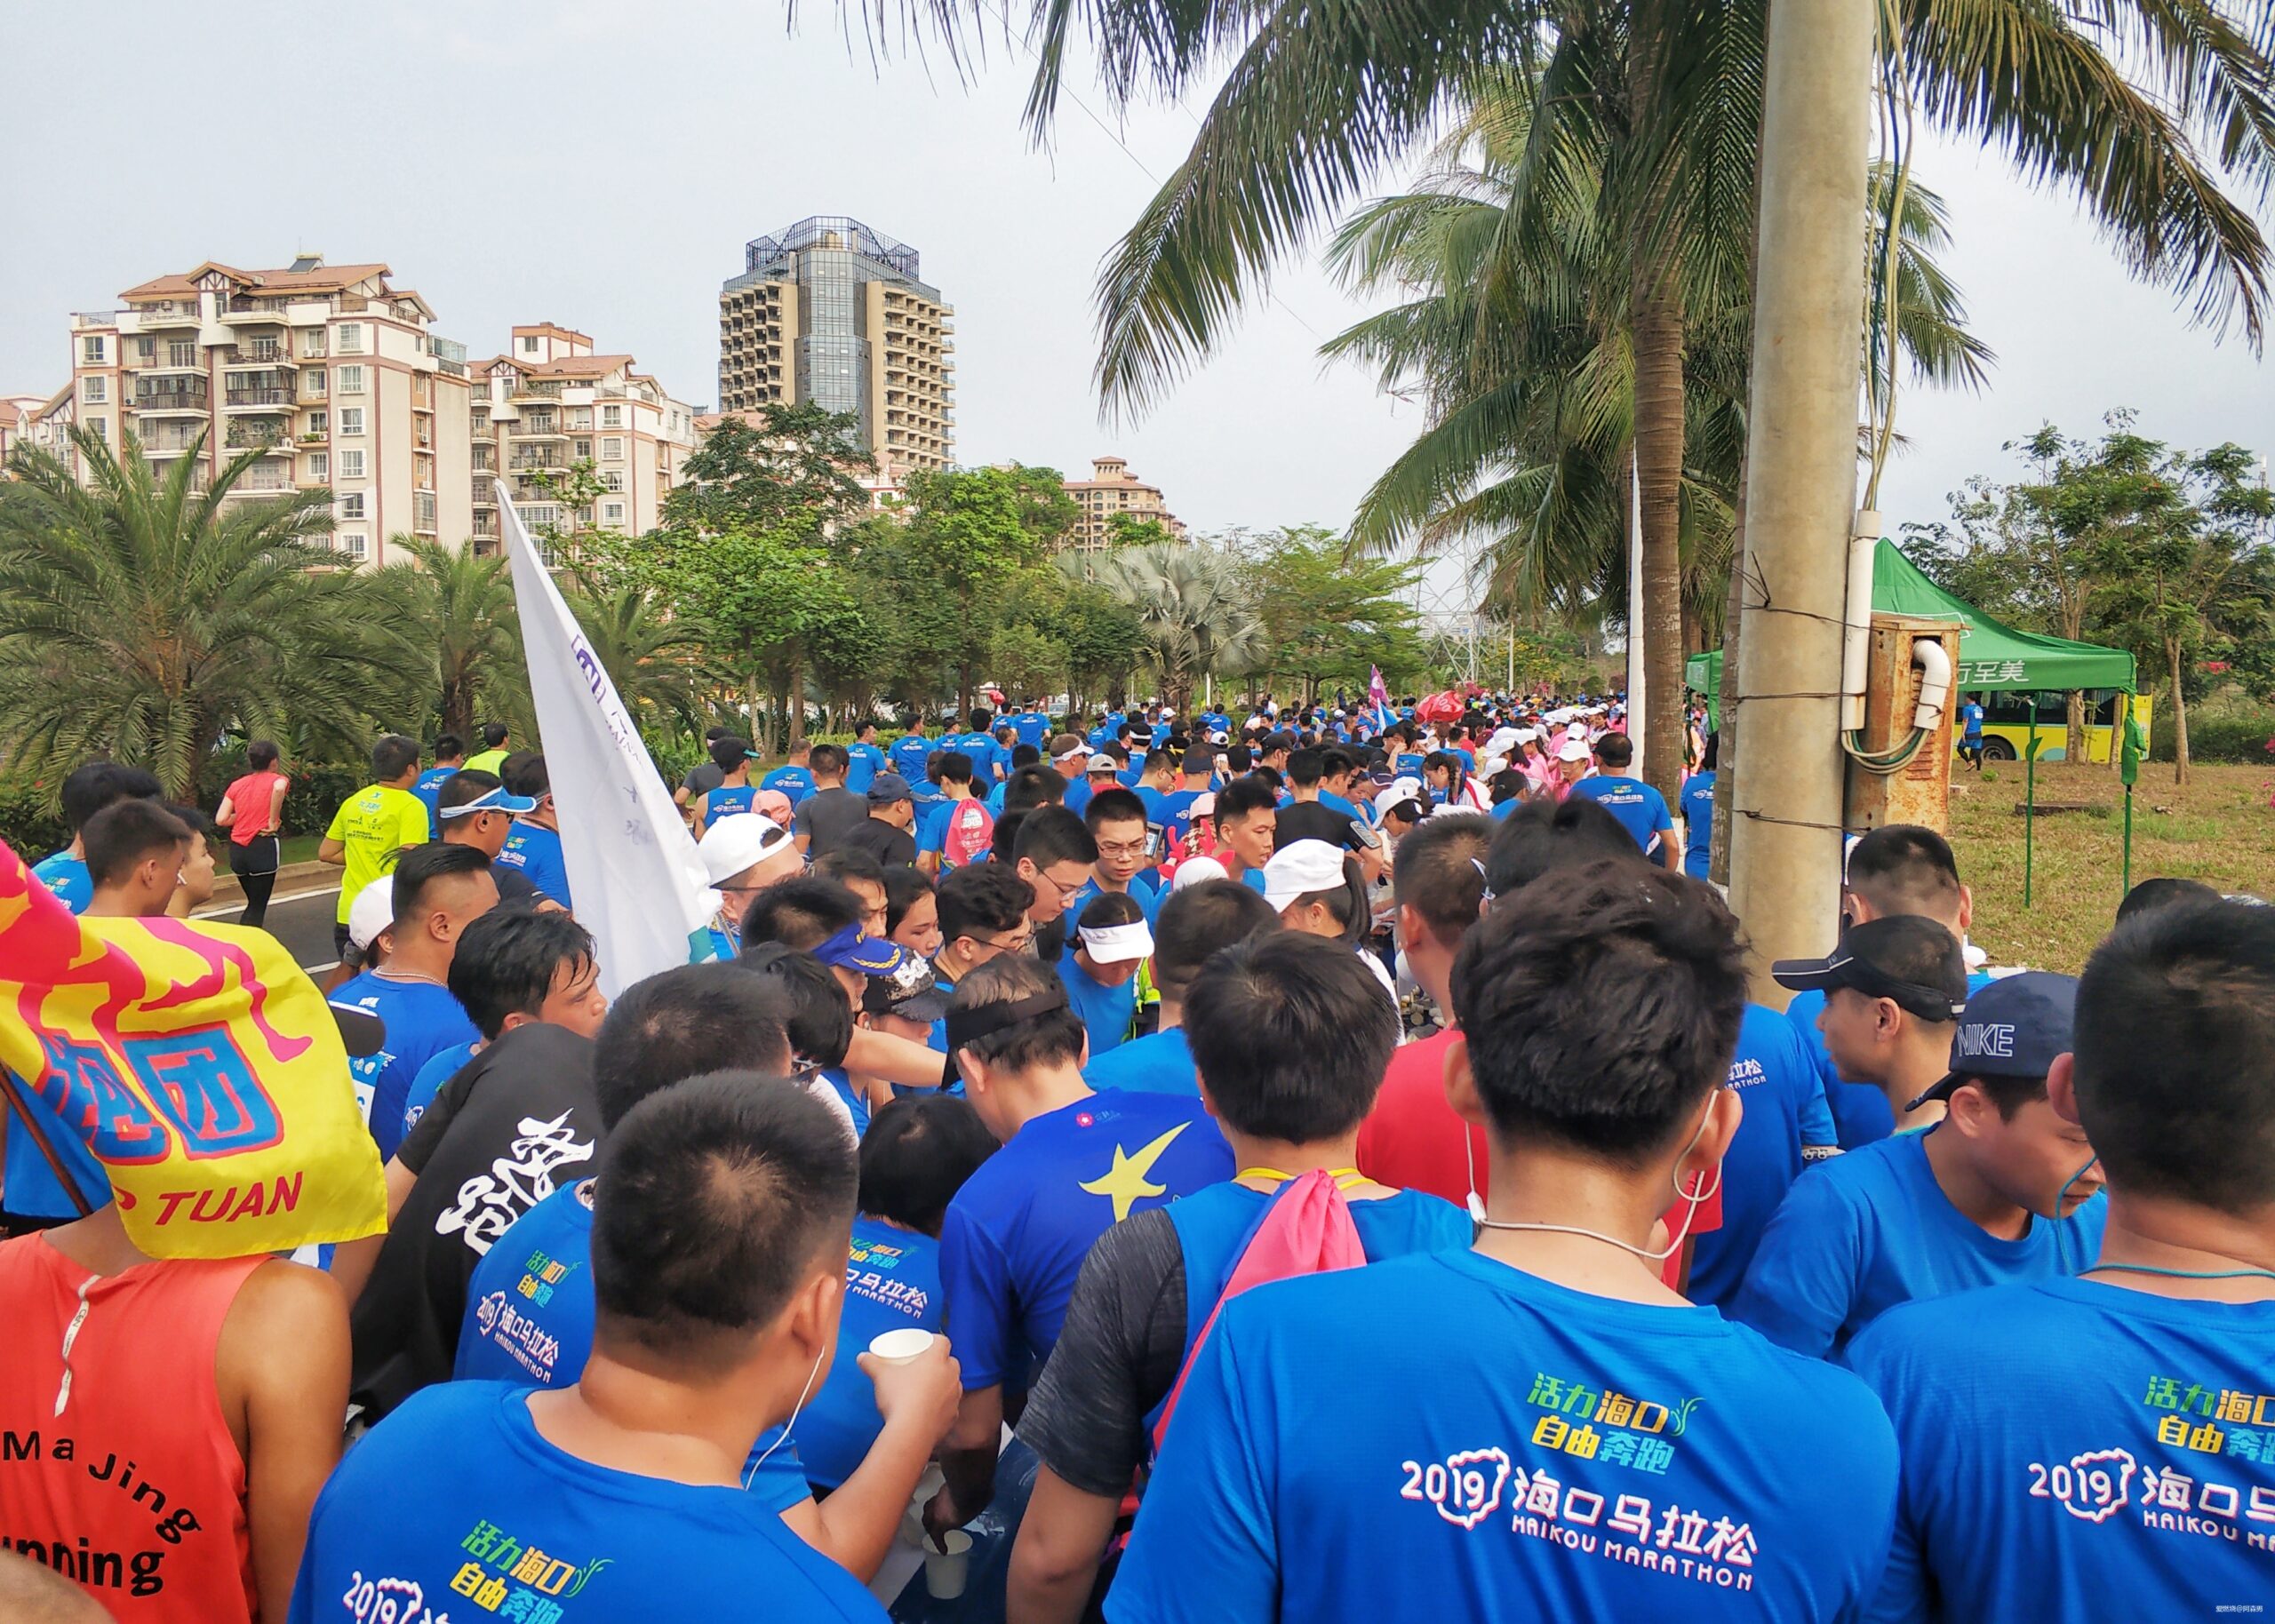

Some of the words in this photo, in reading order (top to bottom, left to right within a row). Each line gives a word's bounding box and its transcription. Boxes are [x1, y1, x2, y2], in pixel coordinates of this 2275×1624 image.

[1957, 1023, 2016, 1057] NIKE
[156, 1172, 303, 1226] TUAN
[852, 1286, 922, 1318] MARATHON
[1527, 1372, 1669, 1435] 活力海口
[1531, 1414, 1675, 1475] 自由奔跑
[1513, 1466, 1760, 1567] 海口马拉松
[2143, 1509, 2238, 1541] HAIKOU
[460, 1519, 576, 1596] 活力海口
[1512, 1514, 1597, 1554] HAIKOU
[1603, 1540, 1754, 1591] MARATHON
